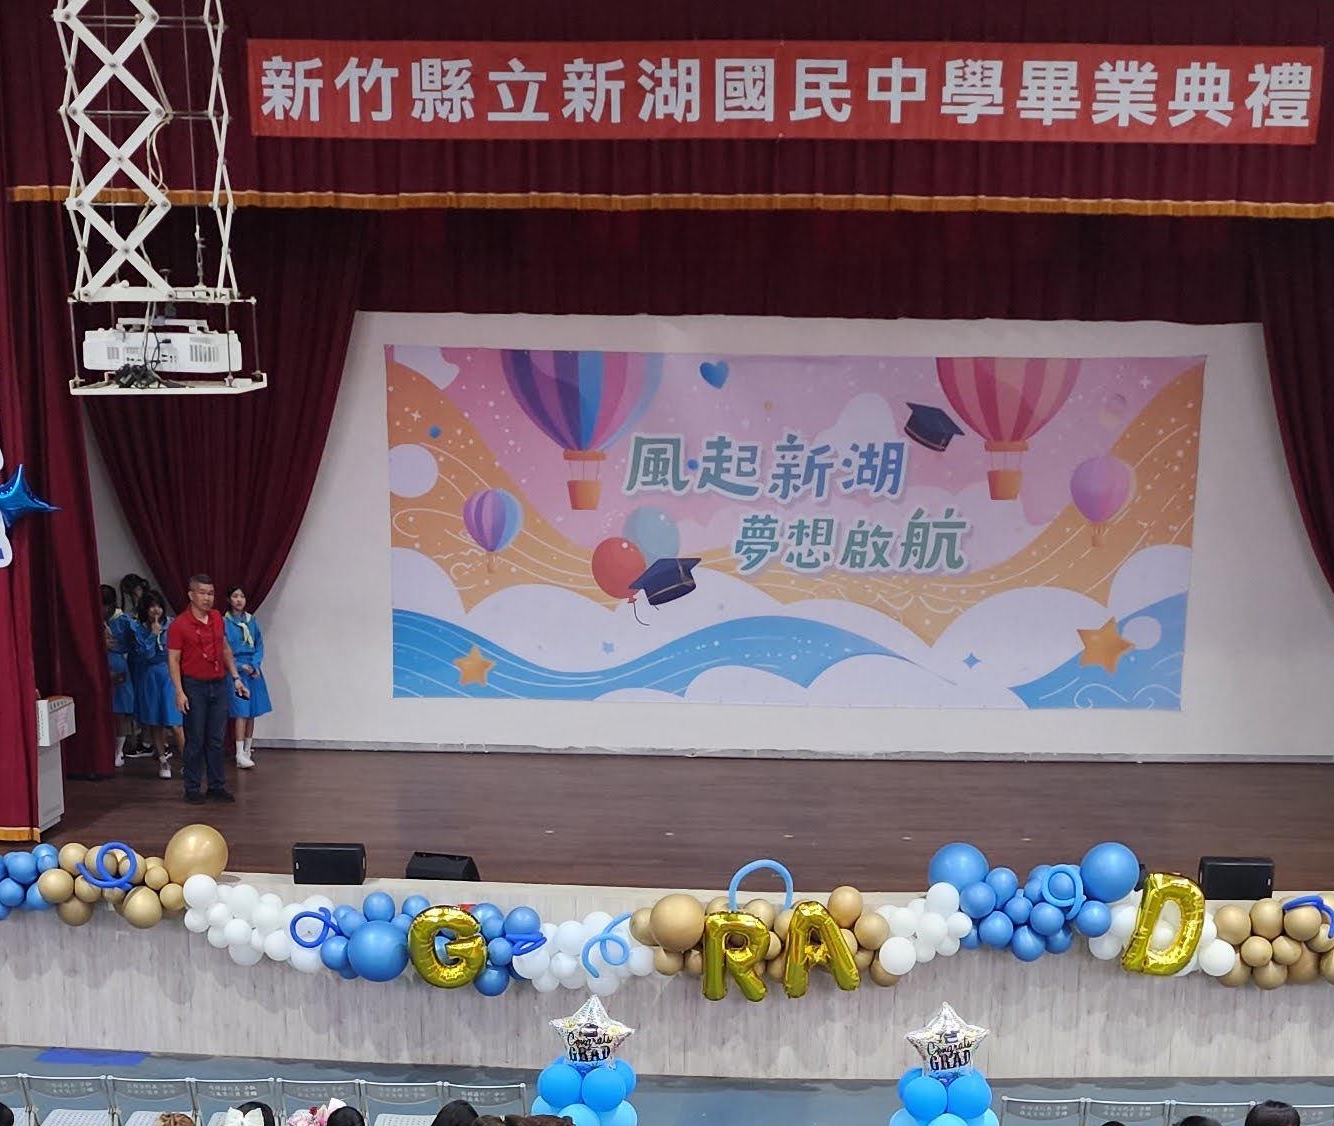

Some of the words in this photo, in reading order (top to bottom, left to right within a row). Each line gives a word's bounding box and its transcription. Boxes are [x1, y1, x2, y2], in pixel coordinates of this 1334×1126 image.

[259, 53, 1315, 129] 新竹縣立新湖國民中學畢業典禮
[624, 432, 908, 500] 風起新湖
[732, 506, 971, 575] 夢想啟航
[930, 1050, 970, 1070] GRAD
